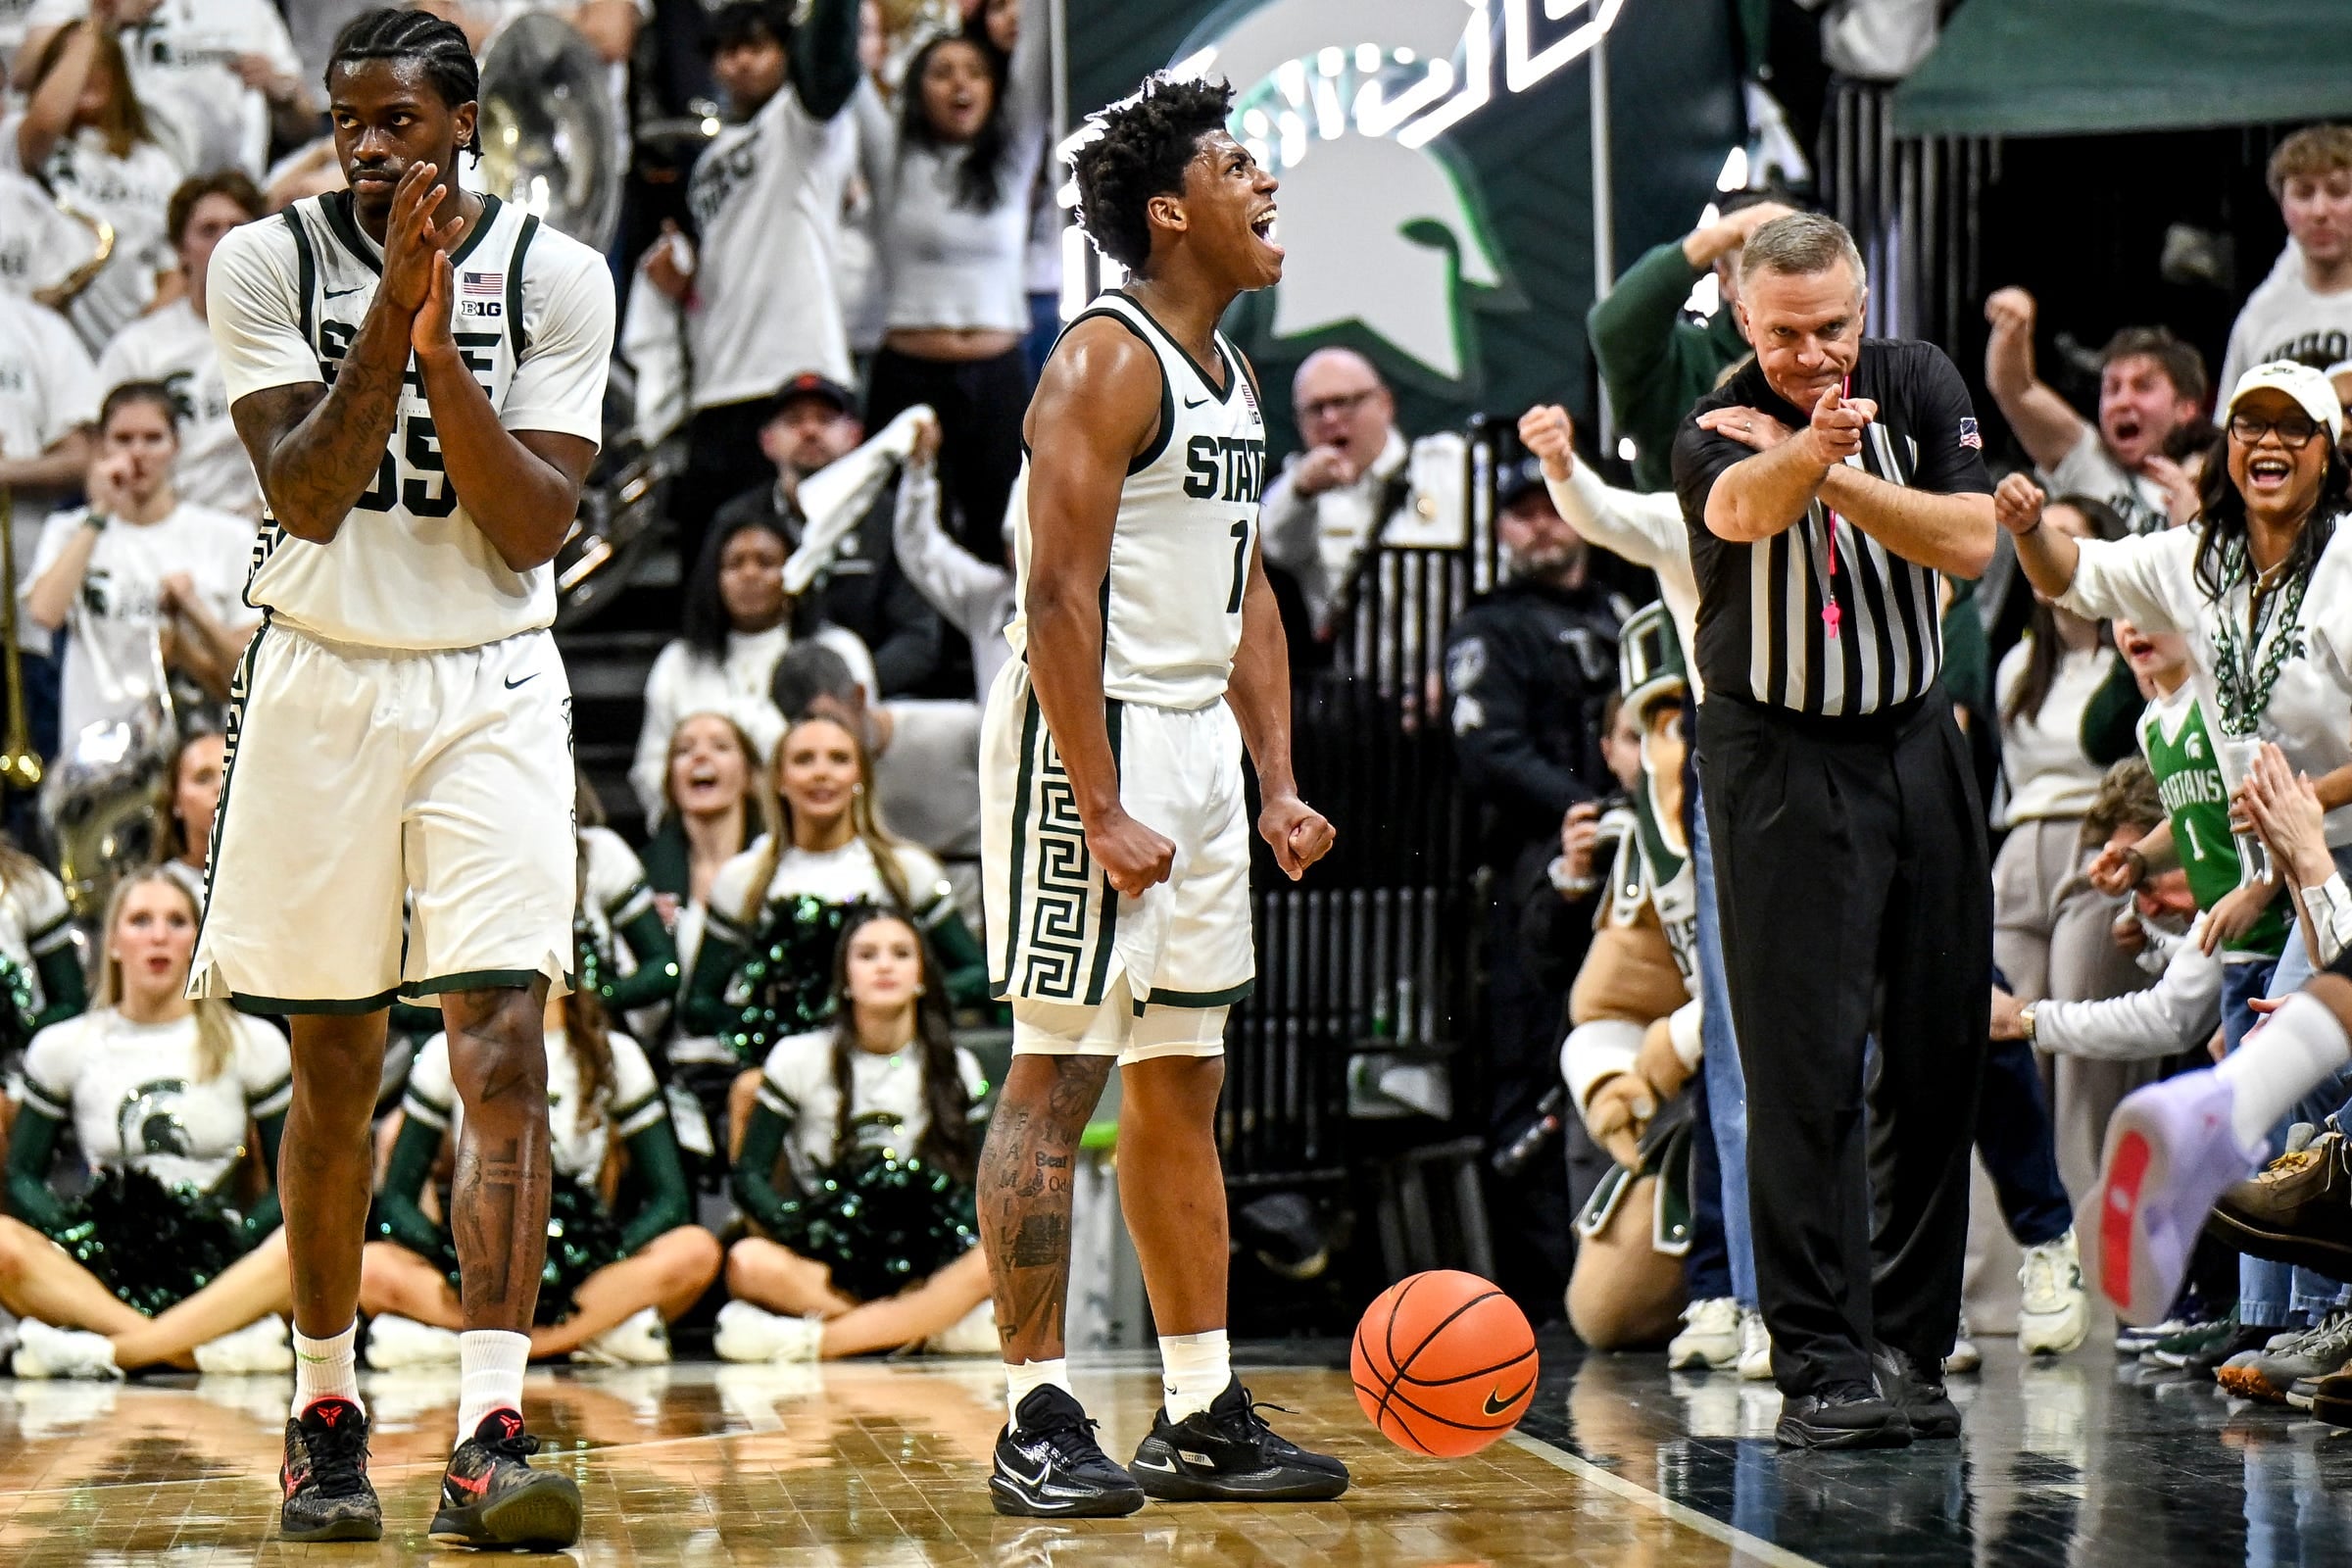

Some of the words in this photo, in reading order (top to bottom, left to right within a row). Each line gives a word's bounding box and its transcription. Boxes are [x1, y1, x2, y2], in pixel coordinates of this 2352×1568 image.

[1182, 434, 1266, 504] STAT
[1225, 519, 1249, 614] 1
[2183, 816, 2205, 861] 1
